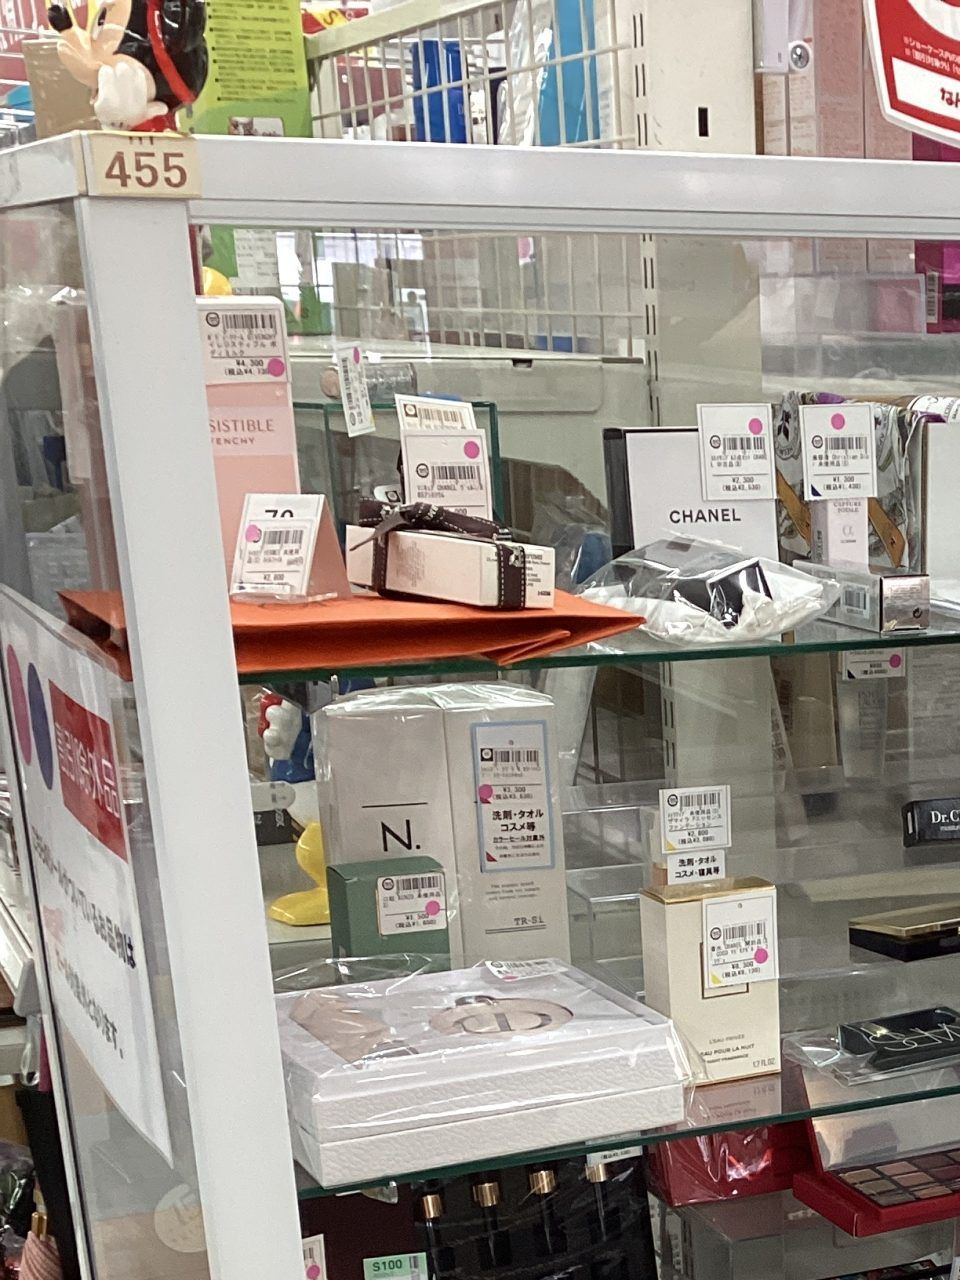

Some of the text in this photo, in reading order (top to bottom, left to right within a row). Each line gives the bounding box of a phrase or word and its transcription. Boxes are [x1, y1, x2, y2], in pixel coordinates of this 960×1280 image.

[104, 151, 189, 189] 455
[669, 508, 742, 524] CHANEL
[492, 809, 544, 821] 洗剤・タオル
[500, 821, 536, 832] コスメ等
[380, 818, 422, 852] N.
[678, 855, 717, 867] 洗剤・タオル
[372, 1258, 403, 1273] S100
